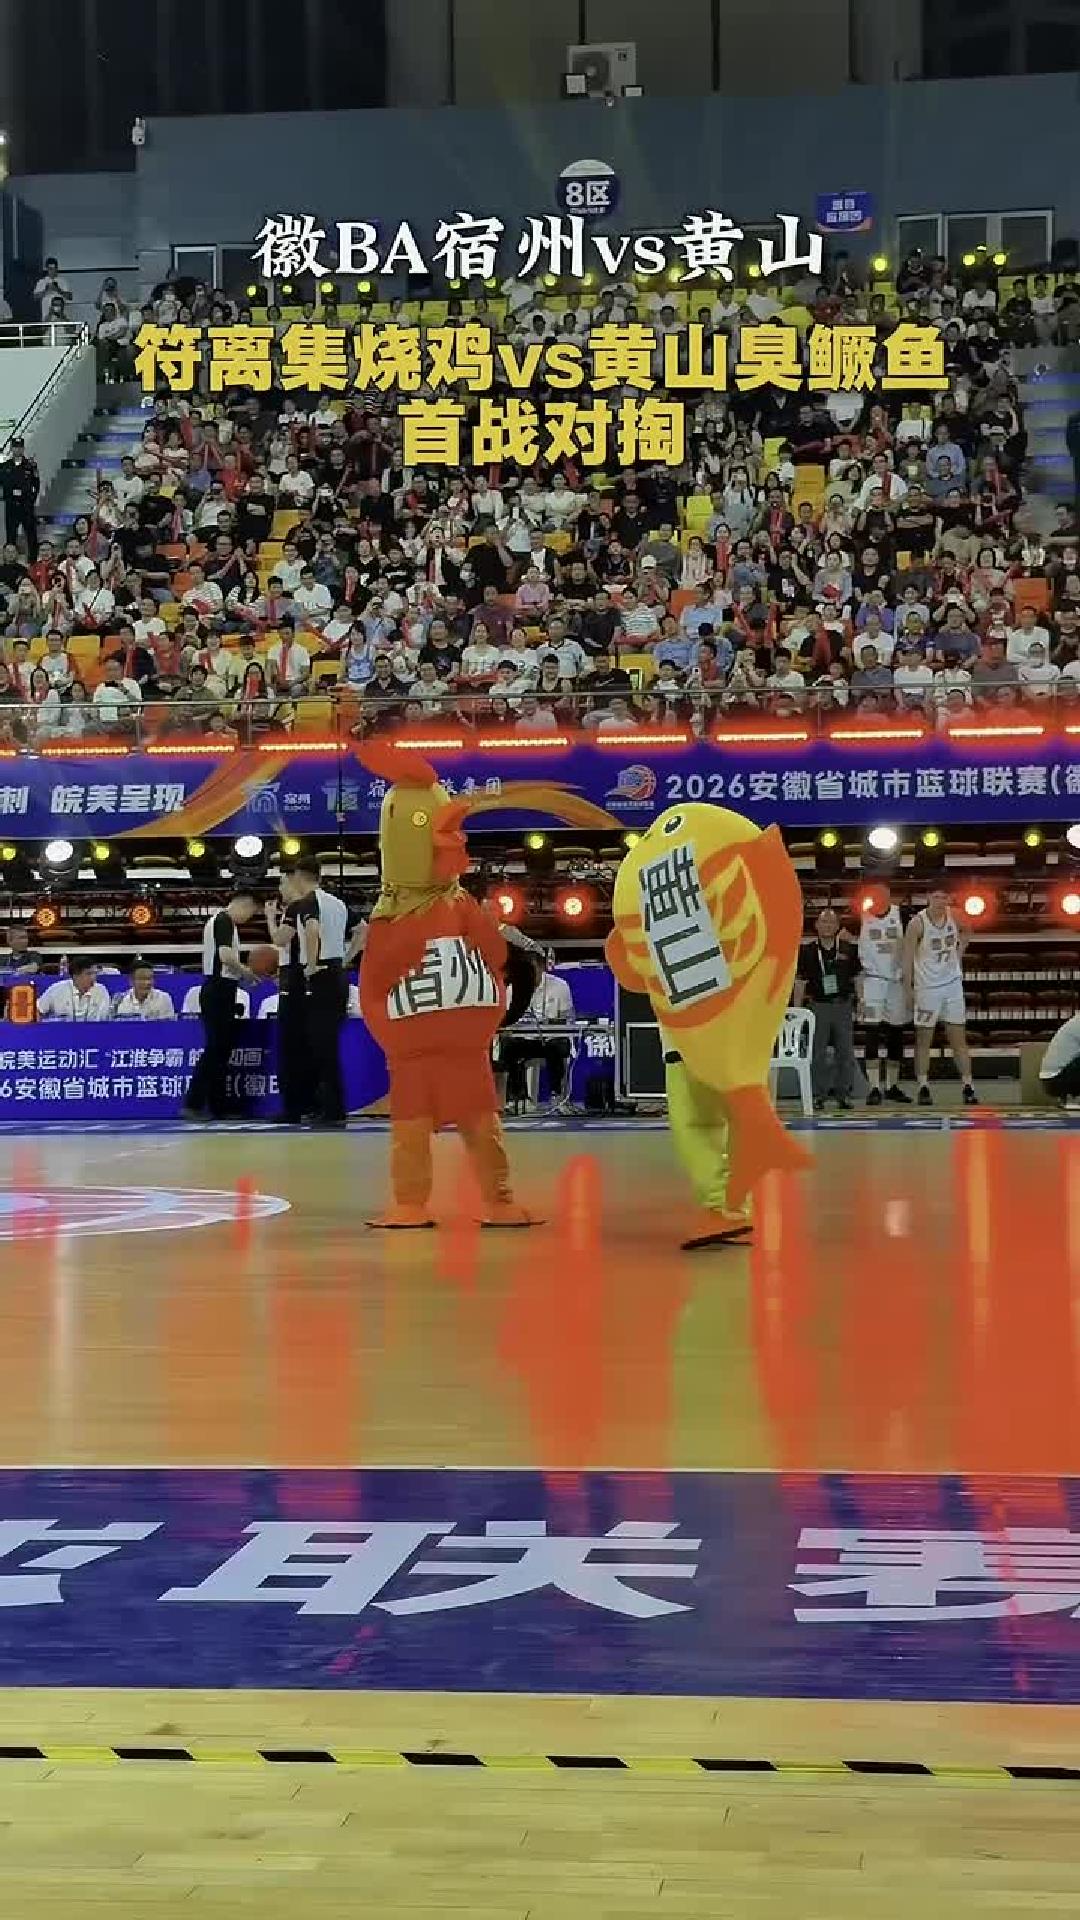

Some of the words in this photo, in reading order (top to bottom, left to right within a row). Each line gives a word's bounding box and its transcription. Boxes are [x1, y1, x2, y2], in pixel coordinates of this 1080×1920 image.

[565, 181, 611, 206] 8区
[51, 783, 185, 814] 皖美呈现
[639, 845, 720, 1004] 黄山
